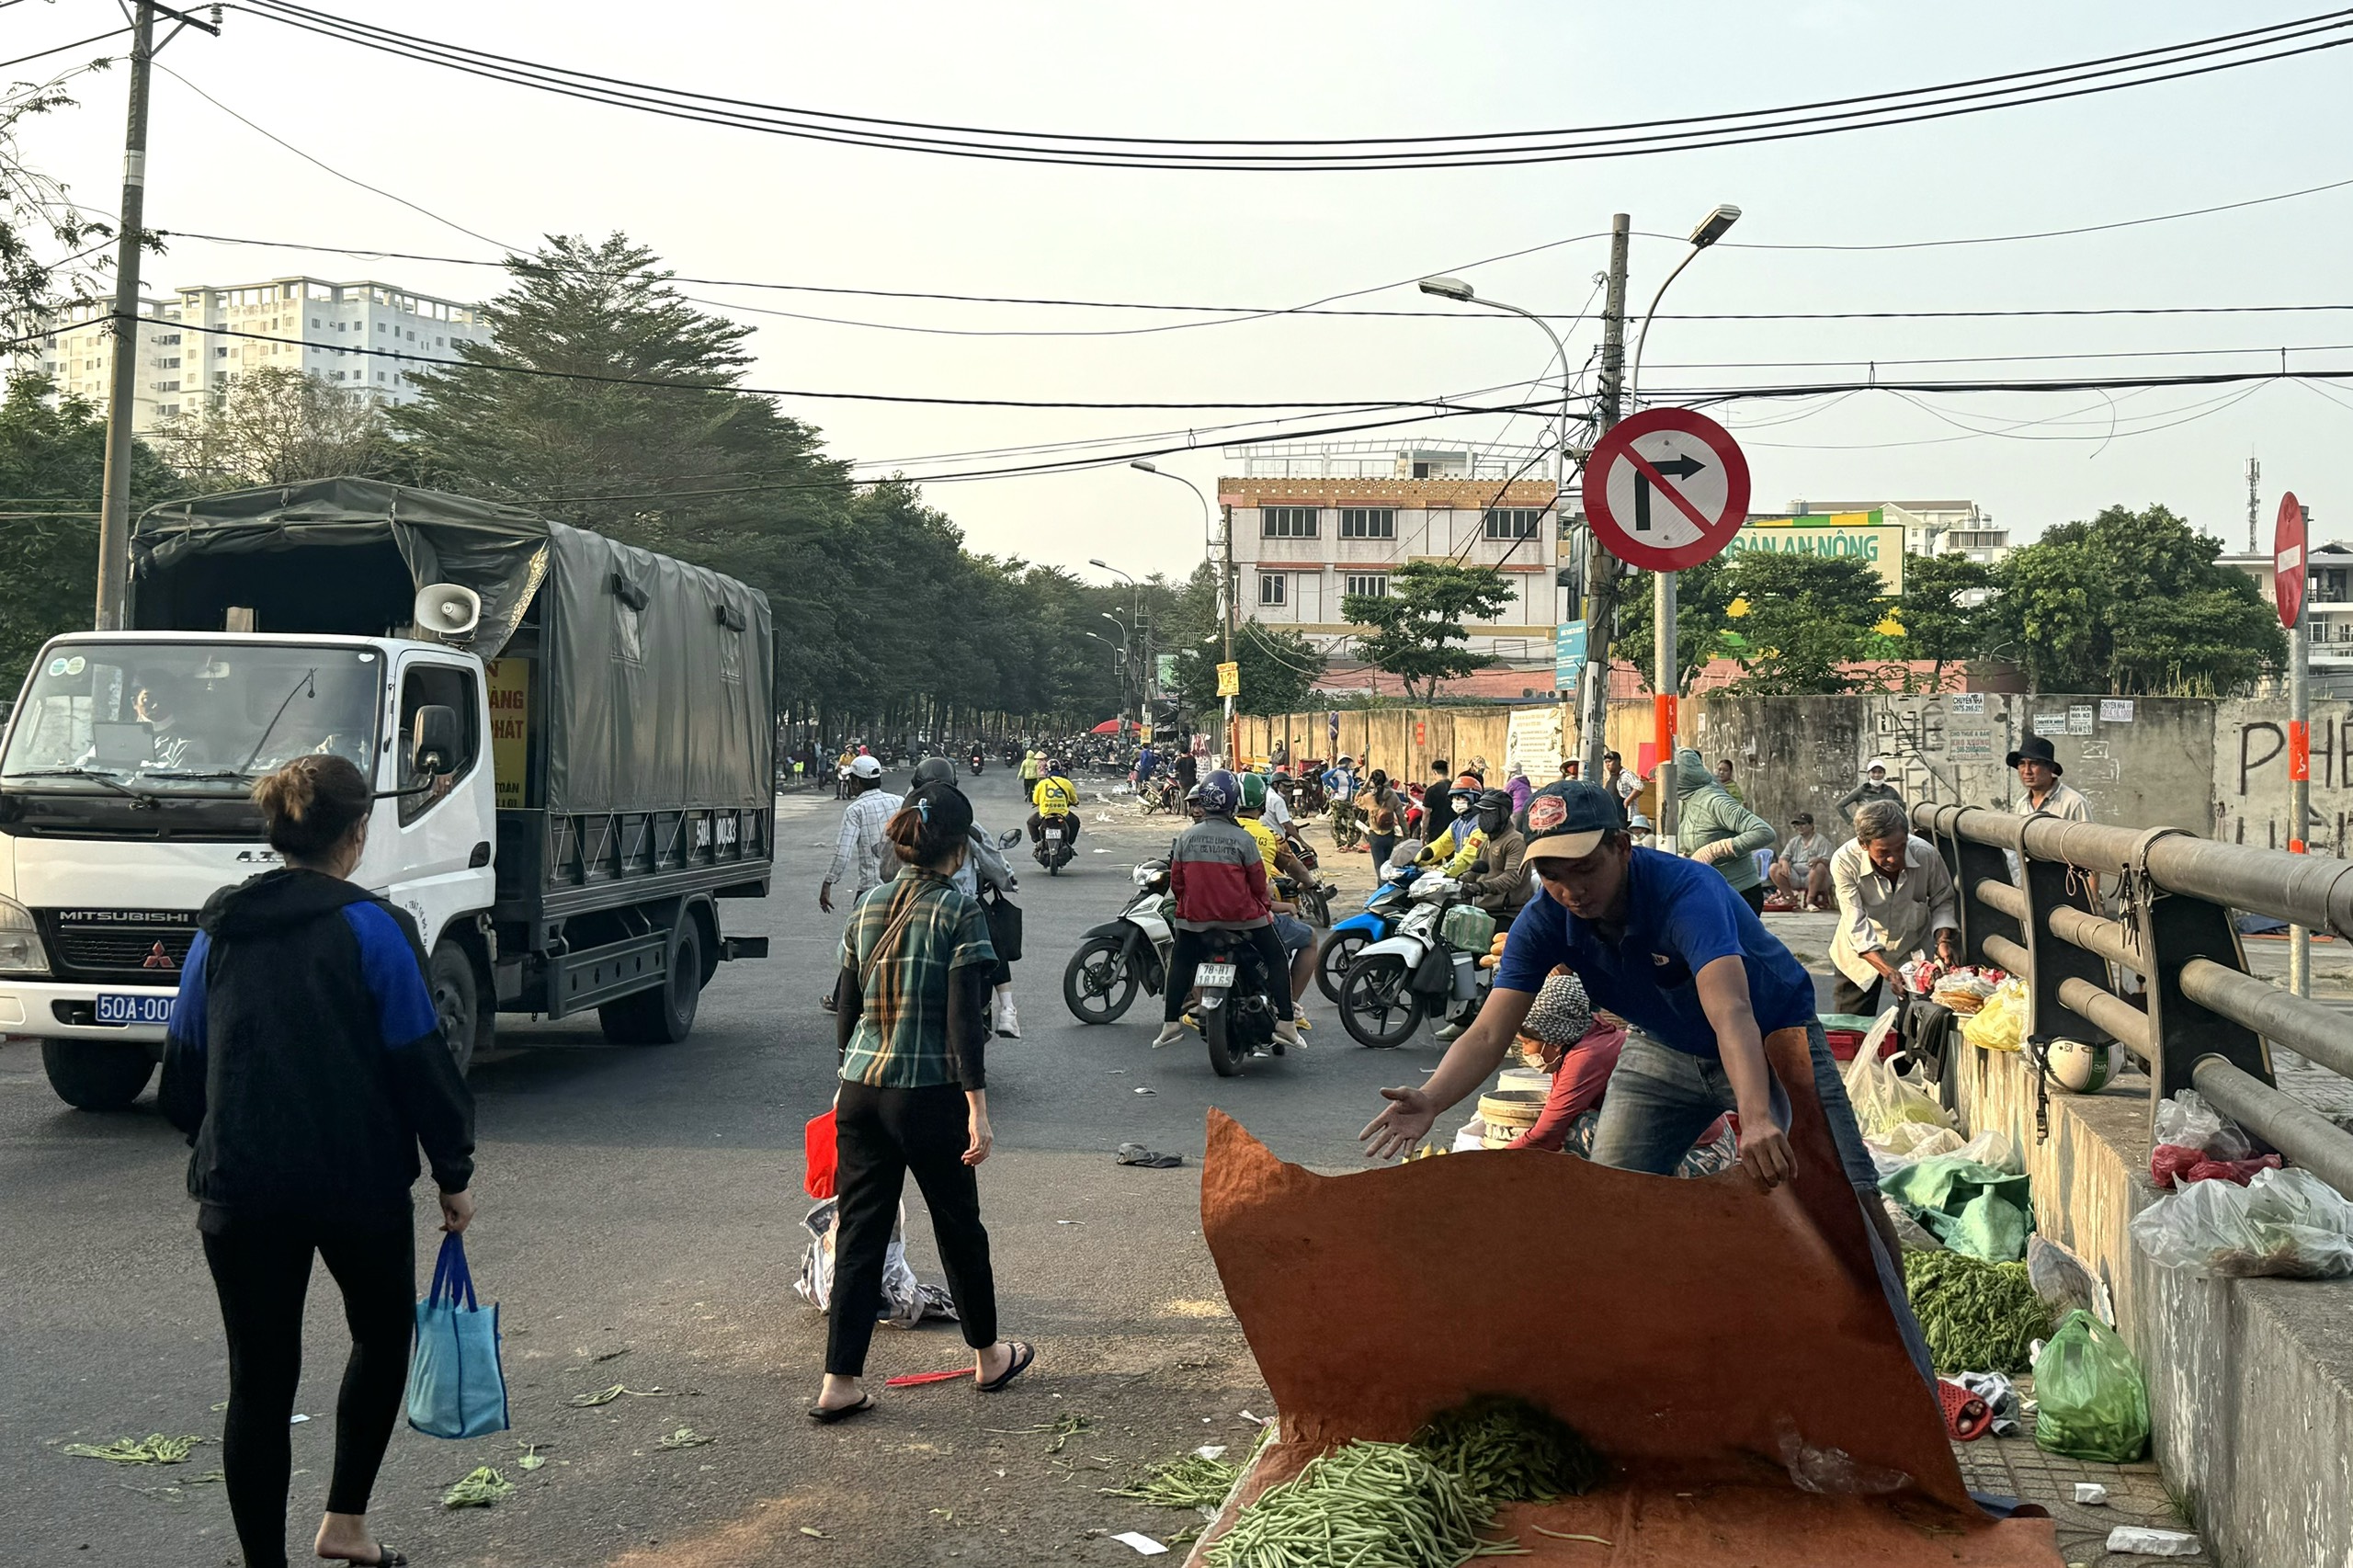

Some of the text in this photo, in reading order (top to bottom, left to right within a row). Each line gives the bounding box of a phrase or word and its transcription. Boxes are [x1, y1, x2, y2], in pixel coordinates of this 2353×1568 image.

[1725, 529, 1879, 562] OÀN AN NÔNG
[491, 716, 524, 739] HÁT
[60, 911, 188, 922] MITSUBISHI
